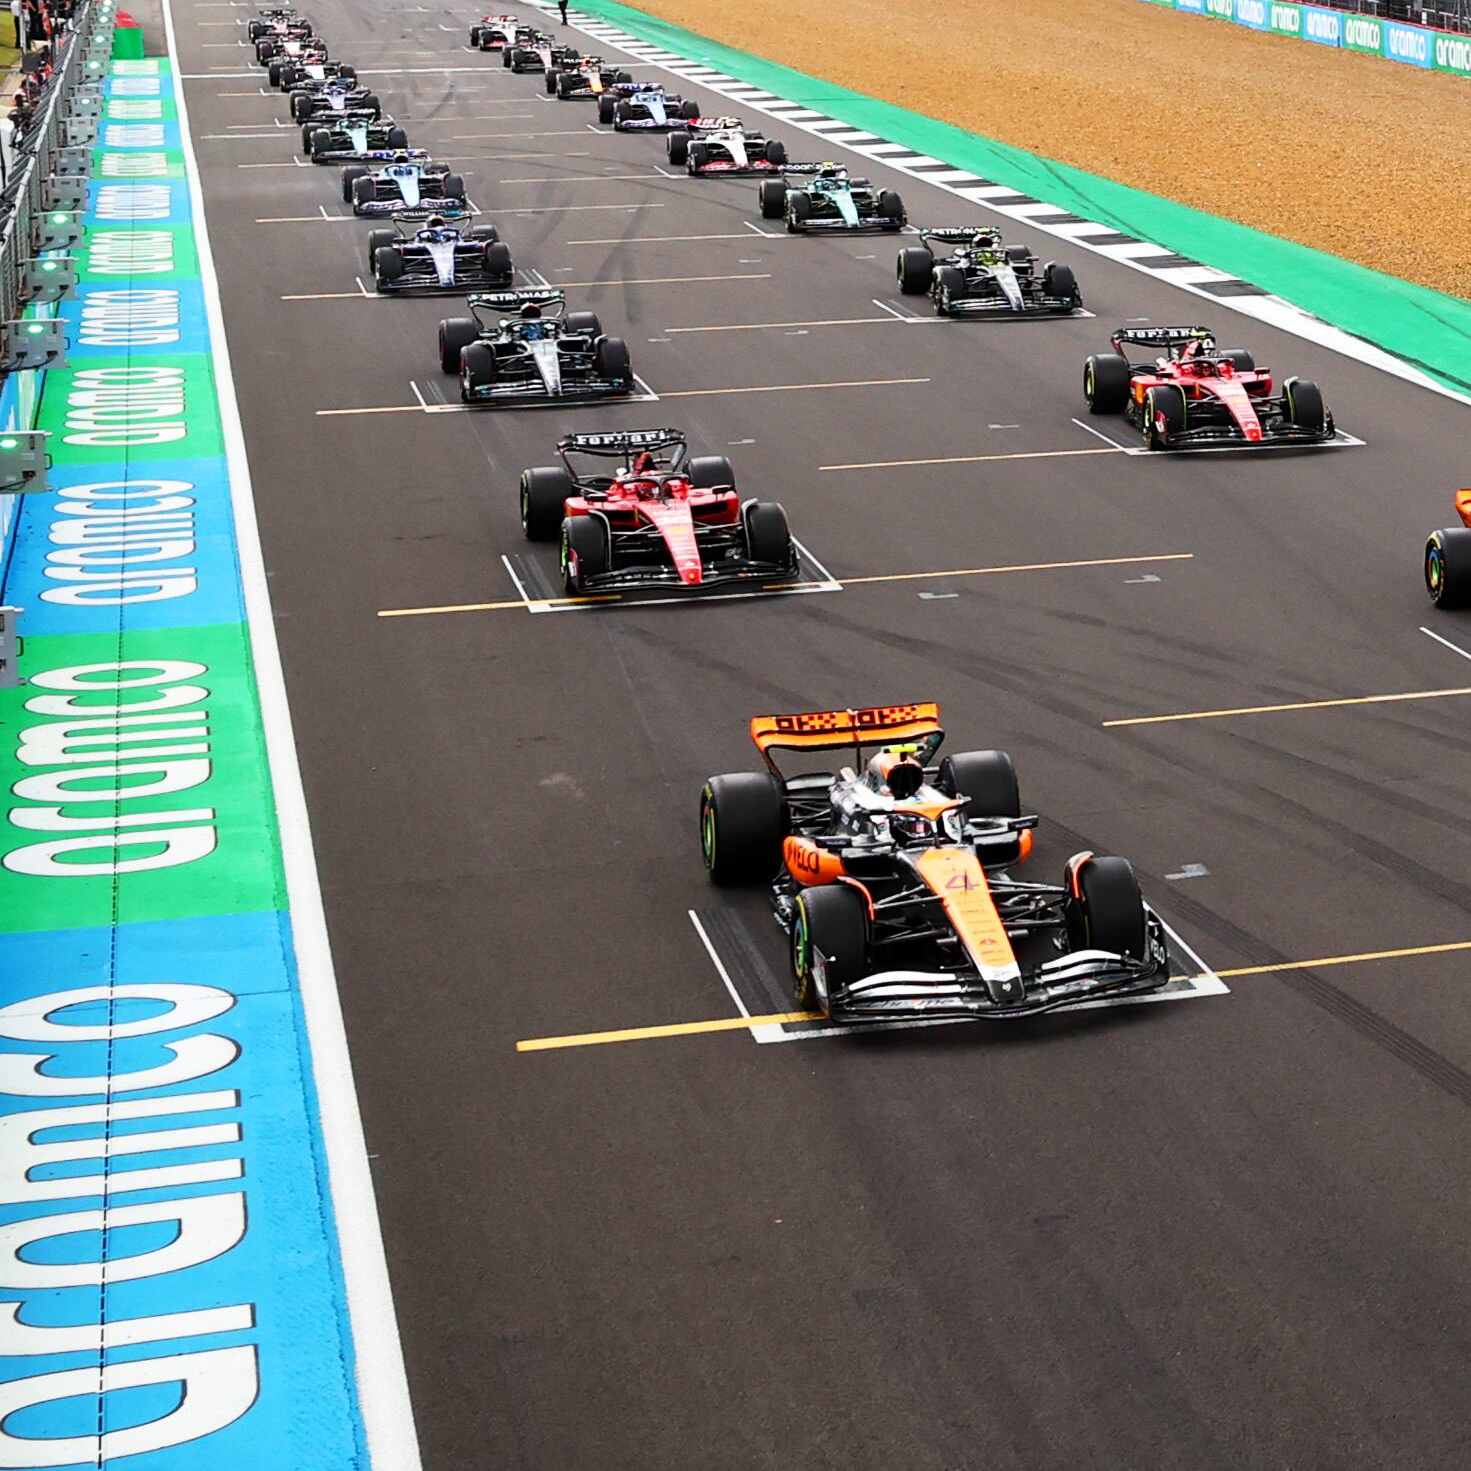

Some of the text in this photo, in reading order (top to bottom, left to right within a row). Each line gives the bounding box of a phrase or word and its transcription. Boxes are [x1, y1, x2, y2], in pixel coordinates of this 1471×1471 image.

[1307, 11, 1338, 40] aramco
[1345, 19, 1380, 50] aramco
[1389, 24, 1426, 61] aramco
[61, 366, 187, 444] aramco
[40, 479, 197, 606] aramco
[1, 660, 220, 877] aramco
[945, 869, 981, 893] 4
